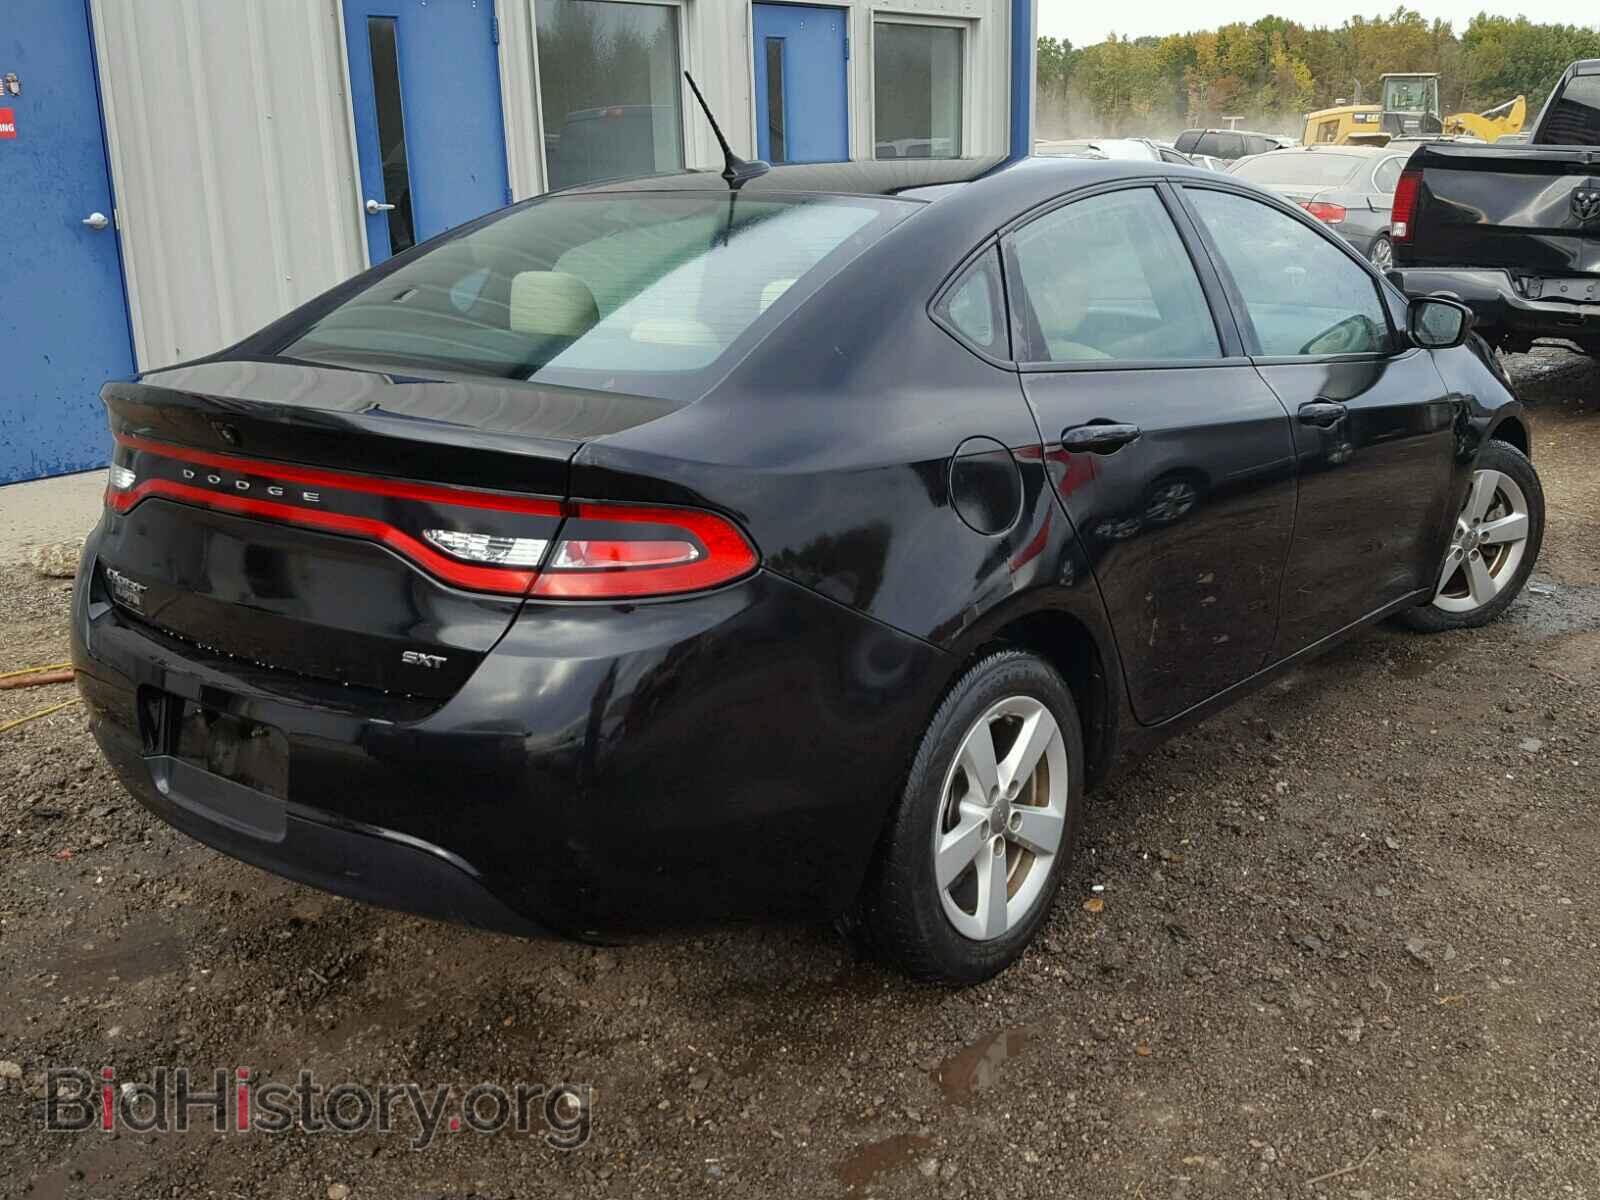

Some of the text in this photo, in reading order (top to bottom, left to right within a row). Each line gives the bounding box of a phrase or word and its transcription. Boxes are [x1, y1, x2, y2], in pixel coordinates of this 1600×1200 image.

[0, 123, 15, 133] ING
[182, 468, 321, 502] DODGE
[401, 650, 448, 669] SXT
